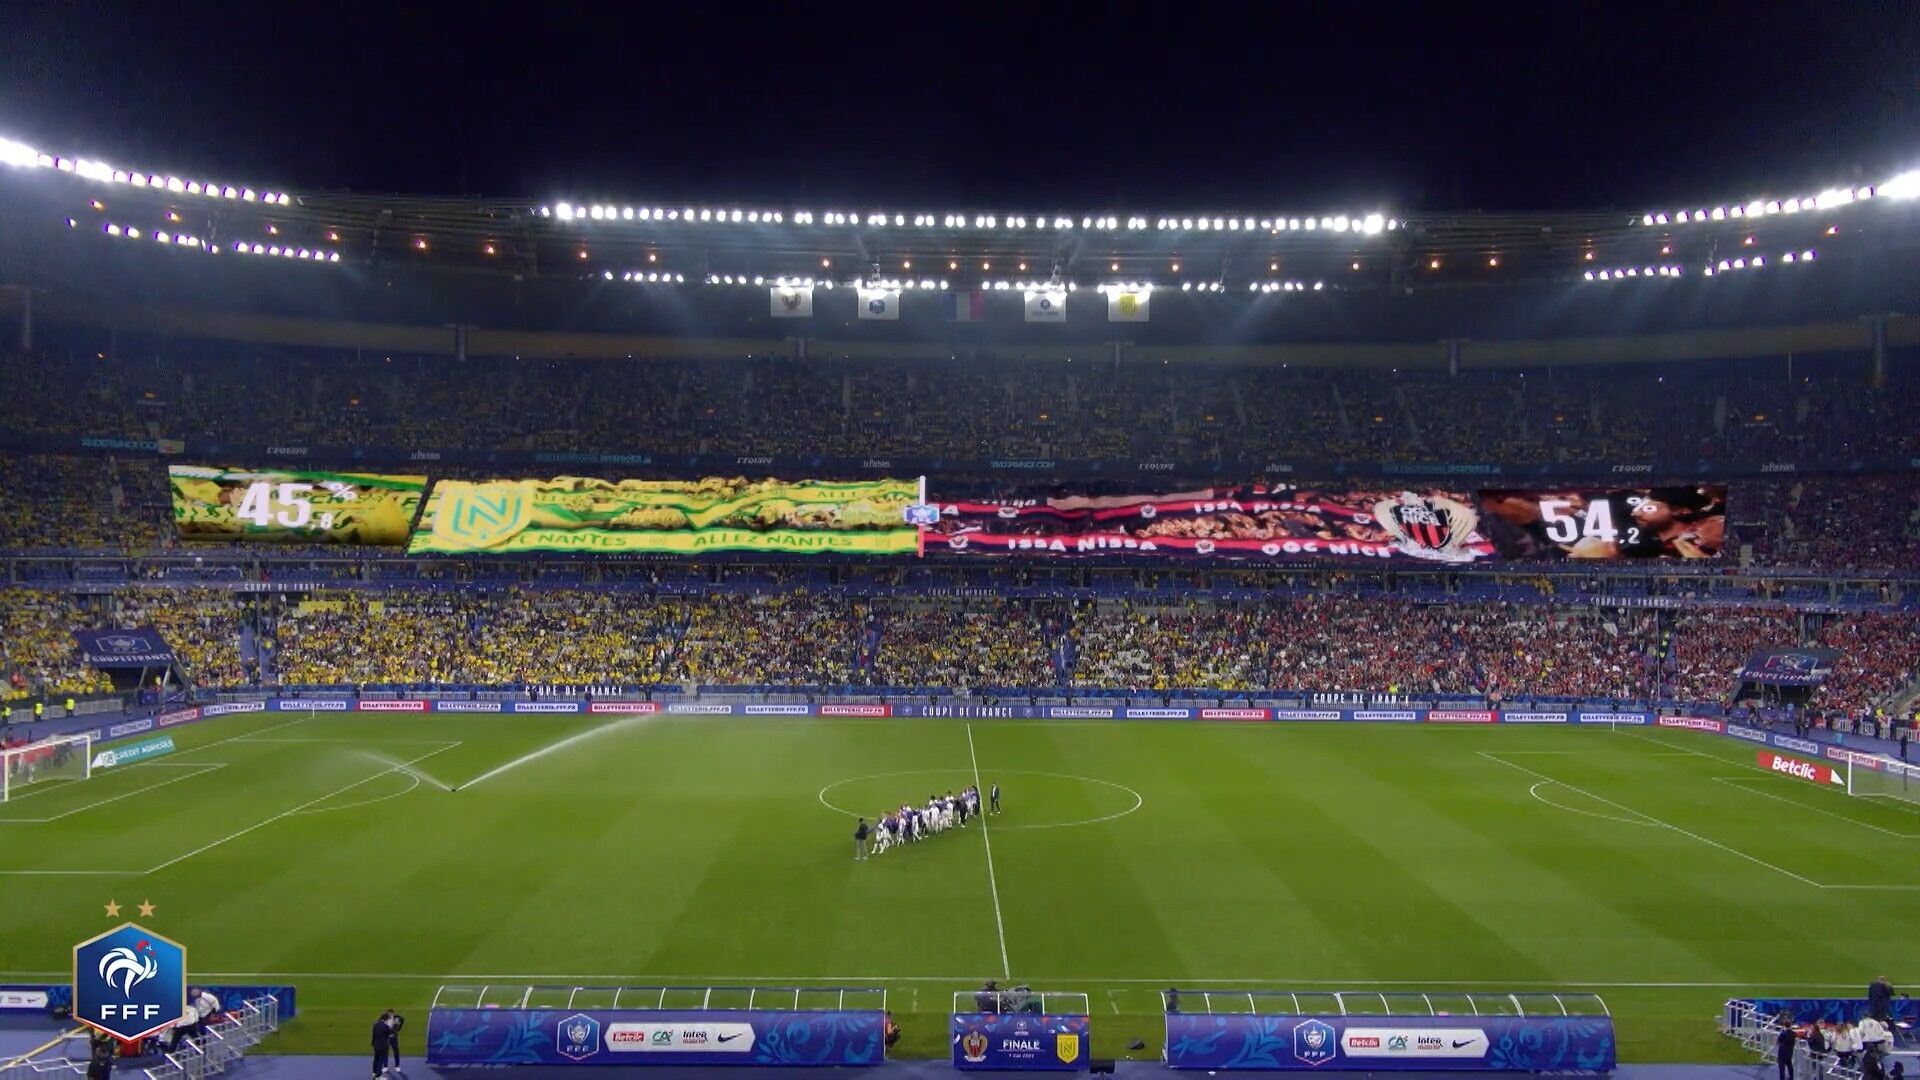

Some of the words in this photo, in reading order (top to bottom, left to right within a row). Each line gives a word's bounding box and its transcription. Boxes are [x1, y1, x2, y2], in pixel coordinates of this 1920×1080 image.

[537, 533, 627, 547] NANTES
[693, 535, 758, 547] ALLEZ
[766, 534, 854, 548] NANTES
[565, 685, 577, 696] DE
[1313, 693, 1345, 704] COUPE
[1353, 693, 1365, 704] DE
[1371, 694, 1409, 704] FRANE
[922, 705, 954, 717] COUPE
[960, 706, 971, 717] DE
[977, 706, 1014, 718] FRANCE
[1772, 755, 1817, 781] Betclic
[1003, 1040, 1041, 1051] FINALE
